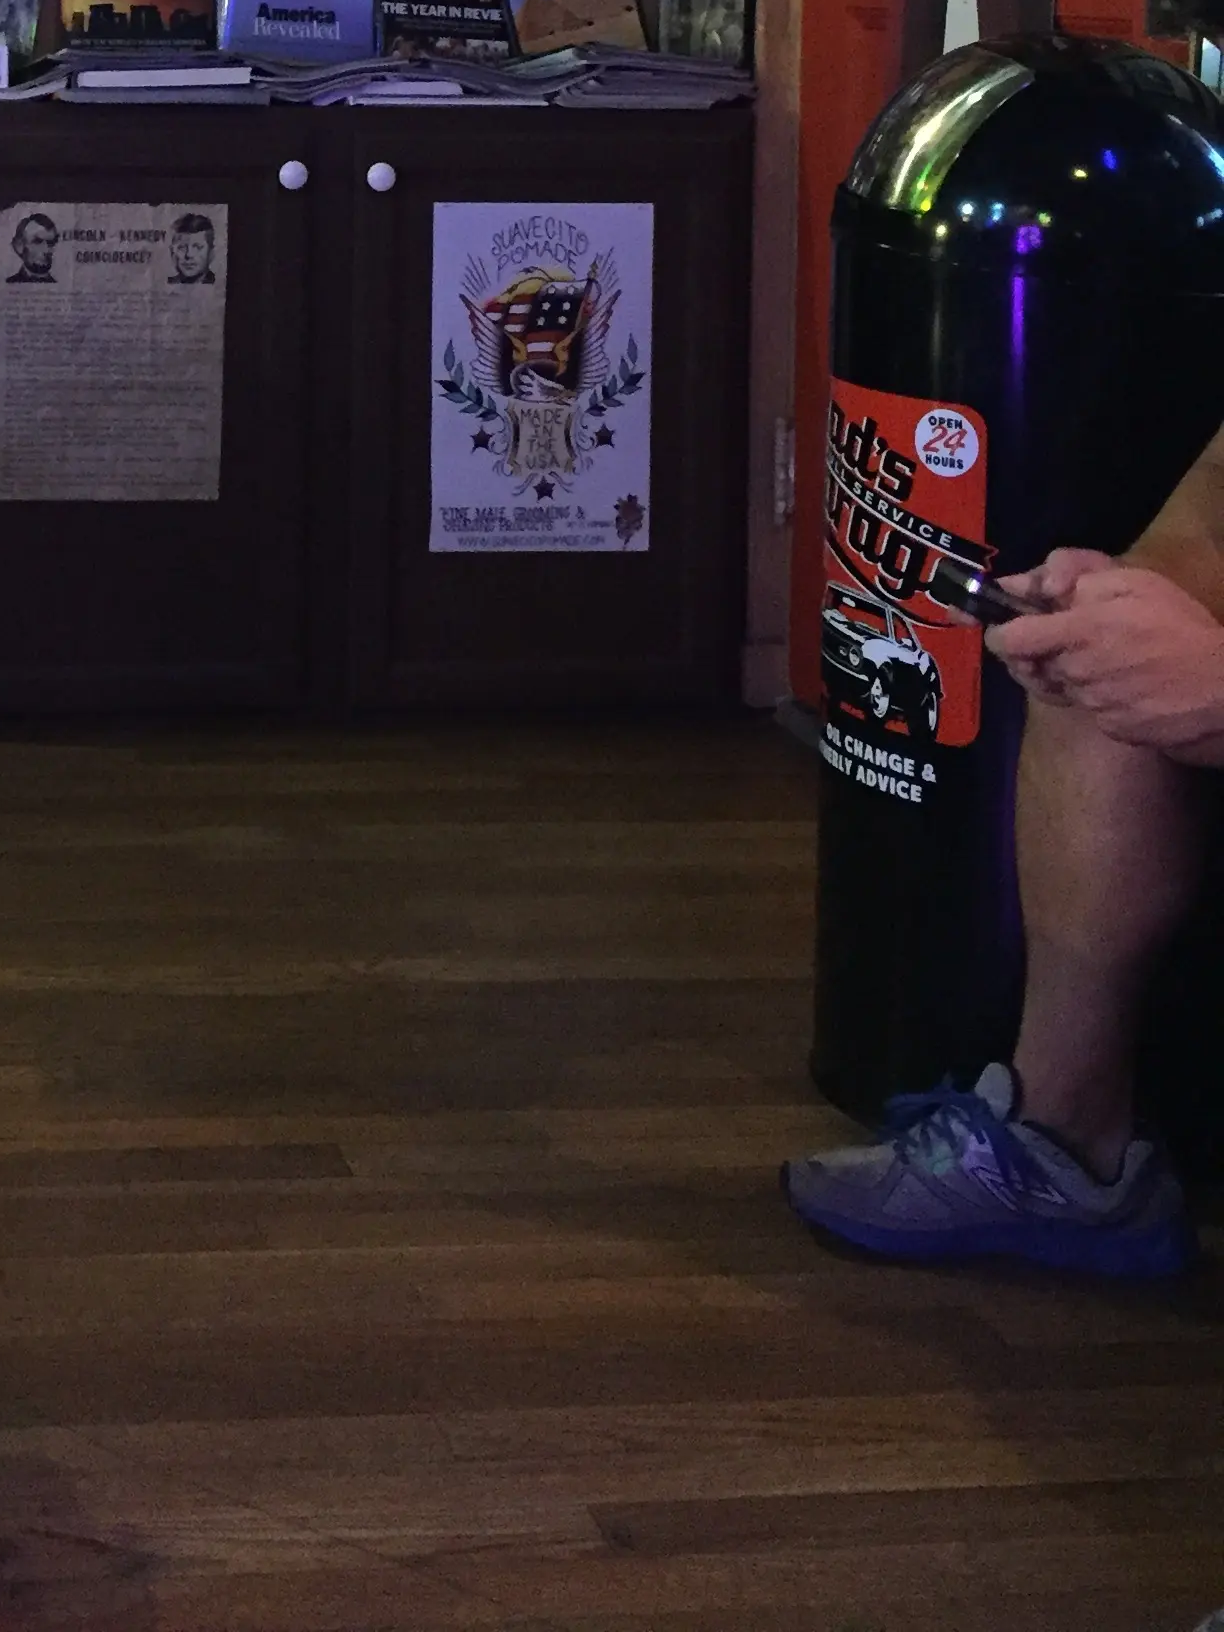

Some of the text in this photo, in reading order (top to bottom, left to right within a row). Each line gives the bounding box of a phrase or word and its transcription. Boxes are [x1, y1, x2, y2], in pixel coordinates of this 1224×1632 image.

[256, 2, 337, 23] America
[382, 1, 503, 21] THE YEAR IN REVIE
[491, 215, 589, 256] SUAVECITO
[497, 240, 579, 284] POMADE
[520, 407, 565, 425] MADE
[928, 415, 963, 430] OPEN
[534, 424, 554, 438] IN
[922, 424, 968, 457] 24
[527, 438, 557, 454] THE
[525, 453, 561, 470] USA
[925, 454, 964, 470] HOURS
[852, 481, 953, 549] SERVICE
[844, 735, 915, 777] CHANGE
[922, 763, 936, 783] &
[856, 764, 923, 803] ADVICE
